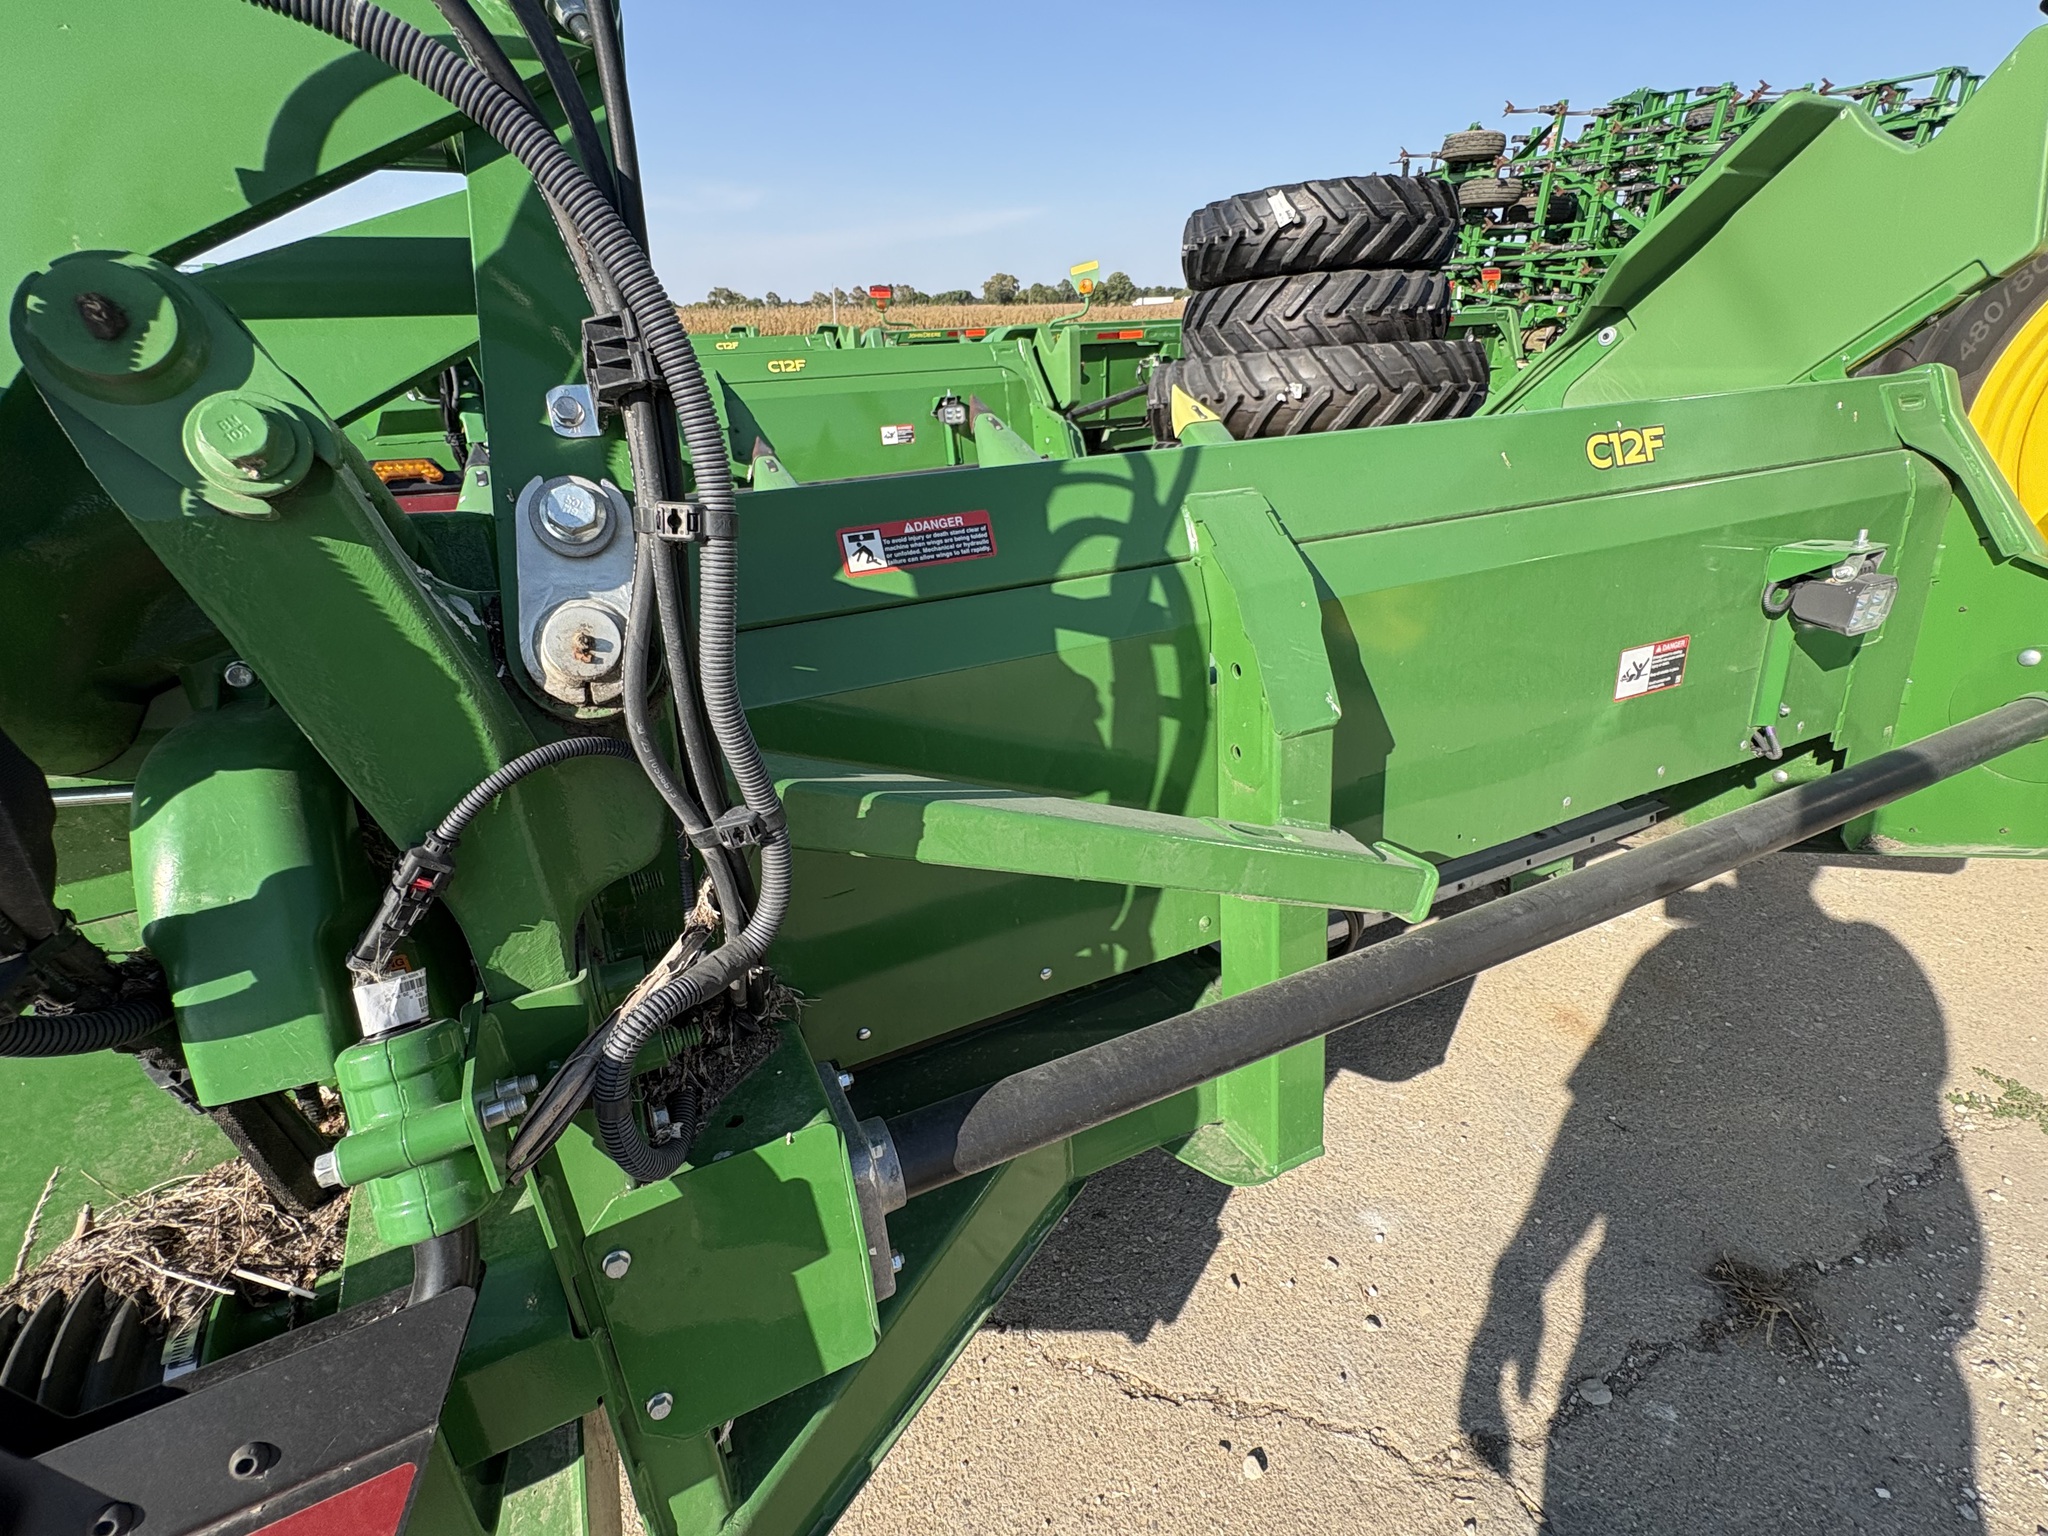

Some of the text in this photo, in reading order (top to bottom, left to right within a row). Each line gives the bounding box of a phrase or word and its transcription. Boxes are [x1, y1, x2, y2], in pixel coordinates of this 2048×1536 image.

[716, 342, 739, 350] C12F
[768, 359, 806, 373] C12F
[1586, 426, 1665, 470] C12F
[914, 516, 964, 532] DANGER
[892, 536, 908, 544] avoid
[908, 534, 925, 543] injury
[950, 528, 965, 536] stand
[888, 558, 907, 566] failure
[920, 553, 935, 561] allow
[936, 551, 953, 559] wings
[970, 545, 992, 554] rapidly.
[894, 549, 922, 557] unfolded.
[923, 544, 955, 553] Mechanical
[963, 539, 989, 548] hydraulic
[1662, 640, 1685, 652] DANGER
